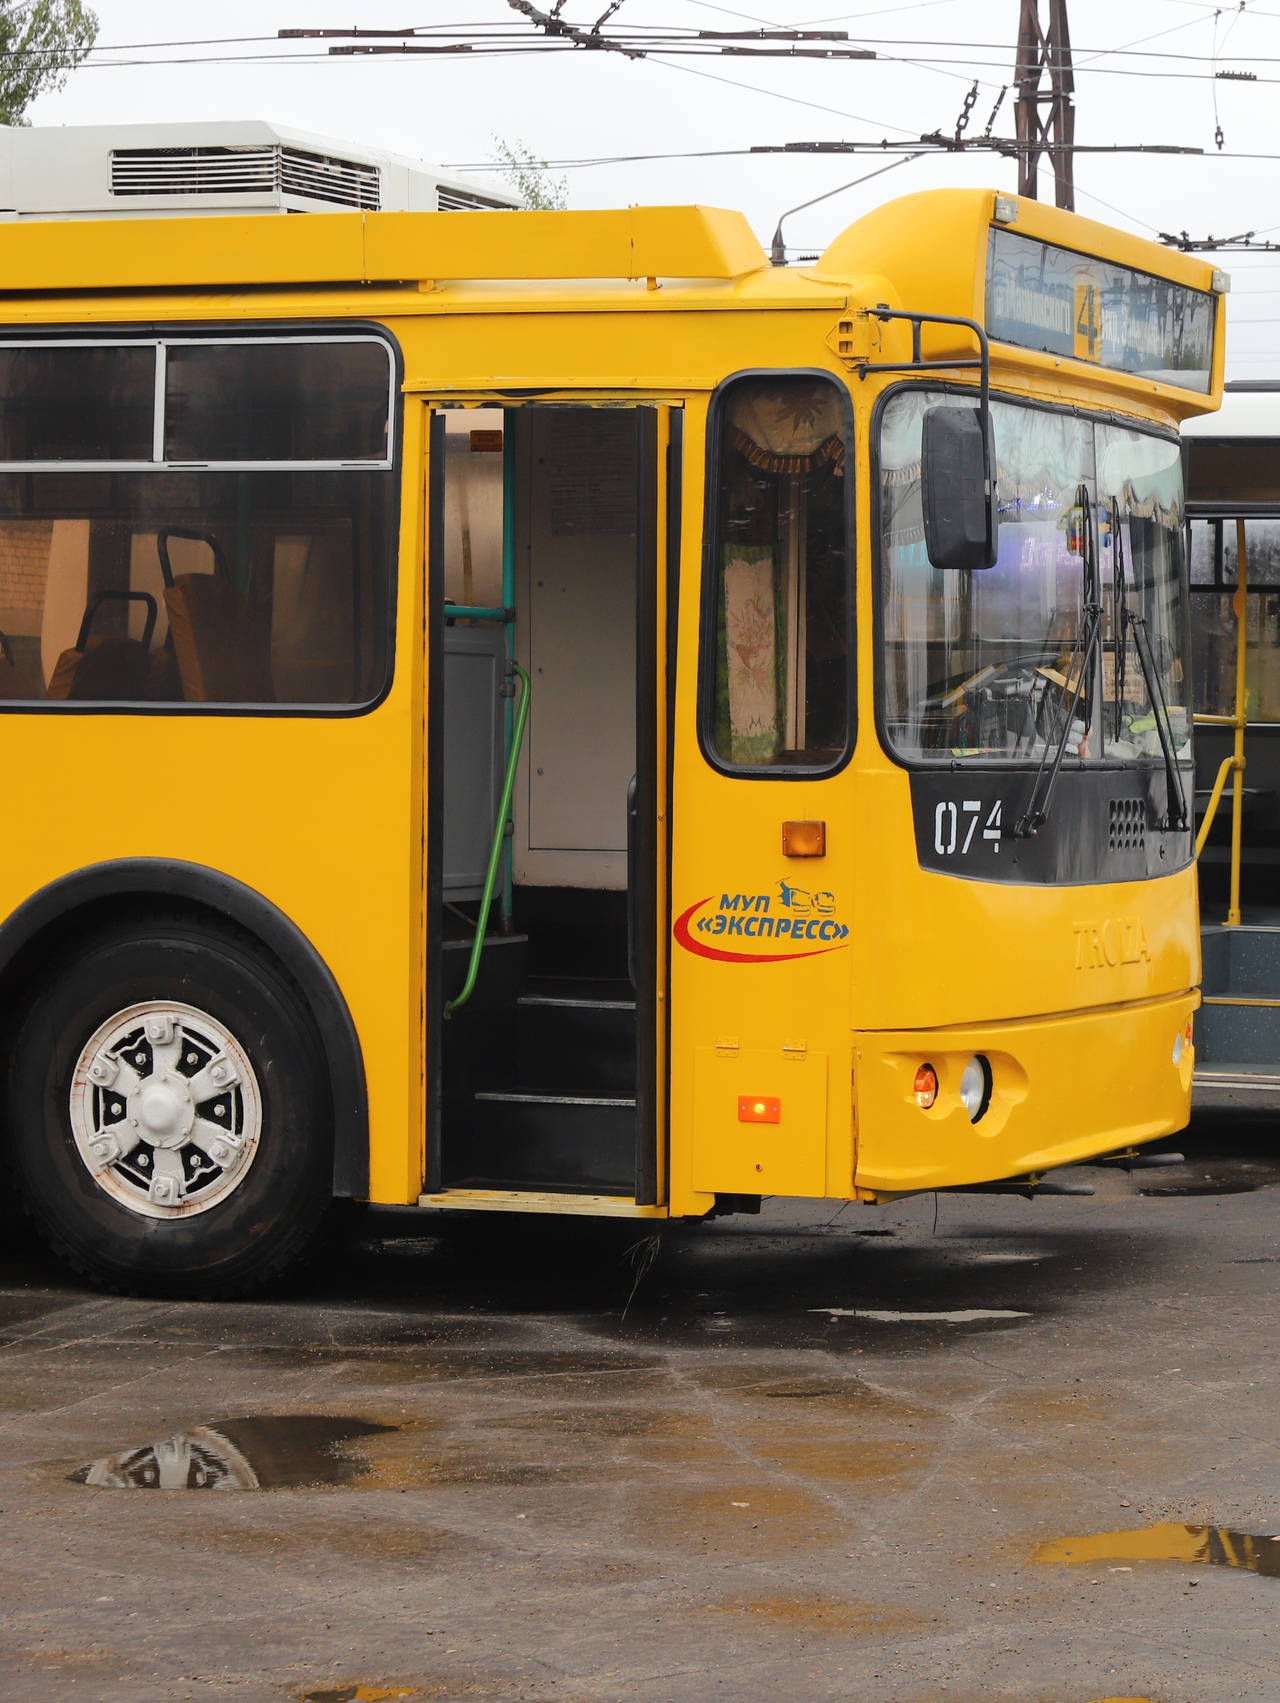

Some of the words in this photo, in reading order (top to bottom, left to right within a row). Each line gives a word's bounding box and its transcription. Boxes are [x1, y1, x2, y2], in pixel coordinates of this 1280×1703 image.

[1077, 285, 1097, 355] 4
[935, 800, 1002, 855] 074
[719, 894, 770, 913] МУП
[696, 915, 850, 940] «ЭКСПРЕСС»
